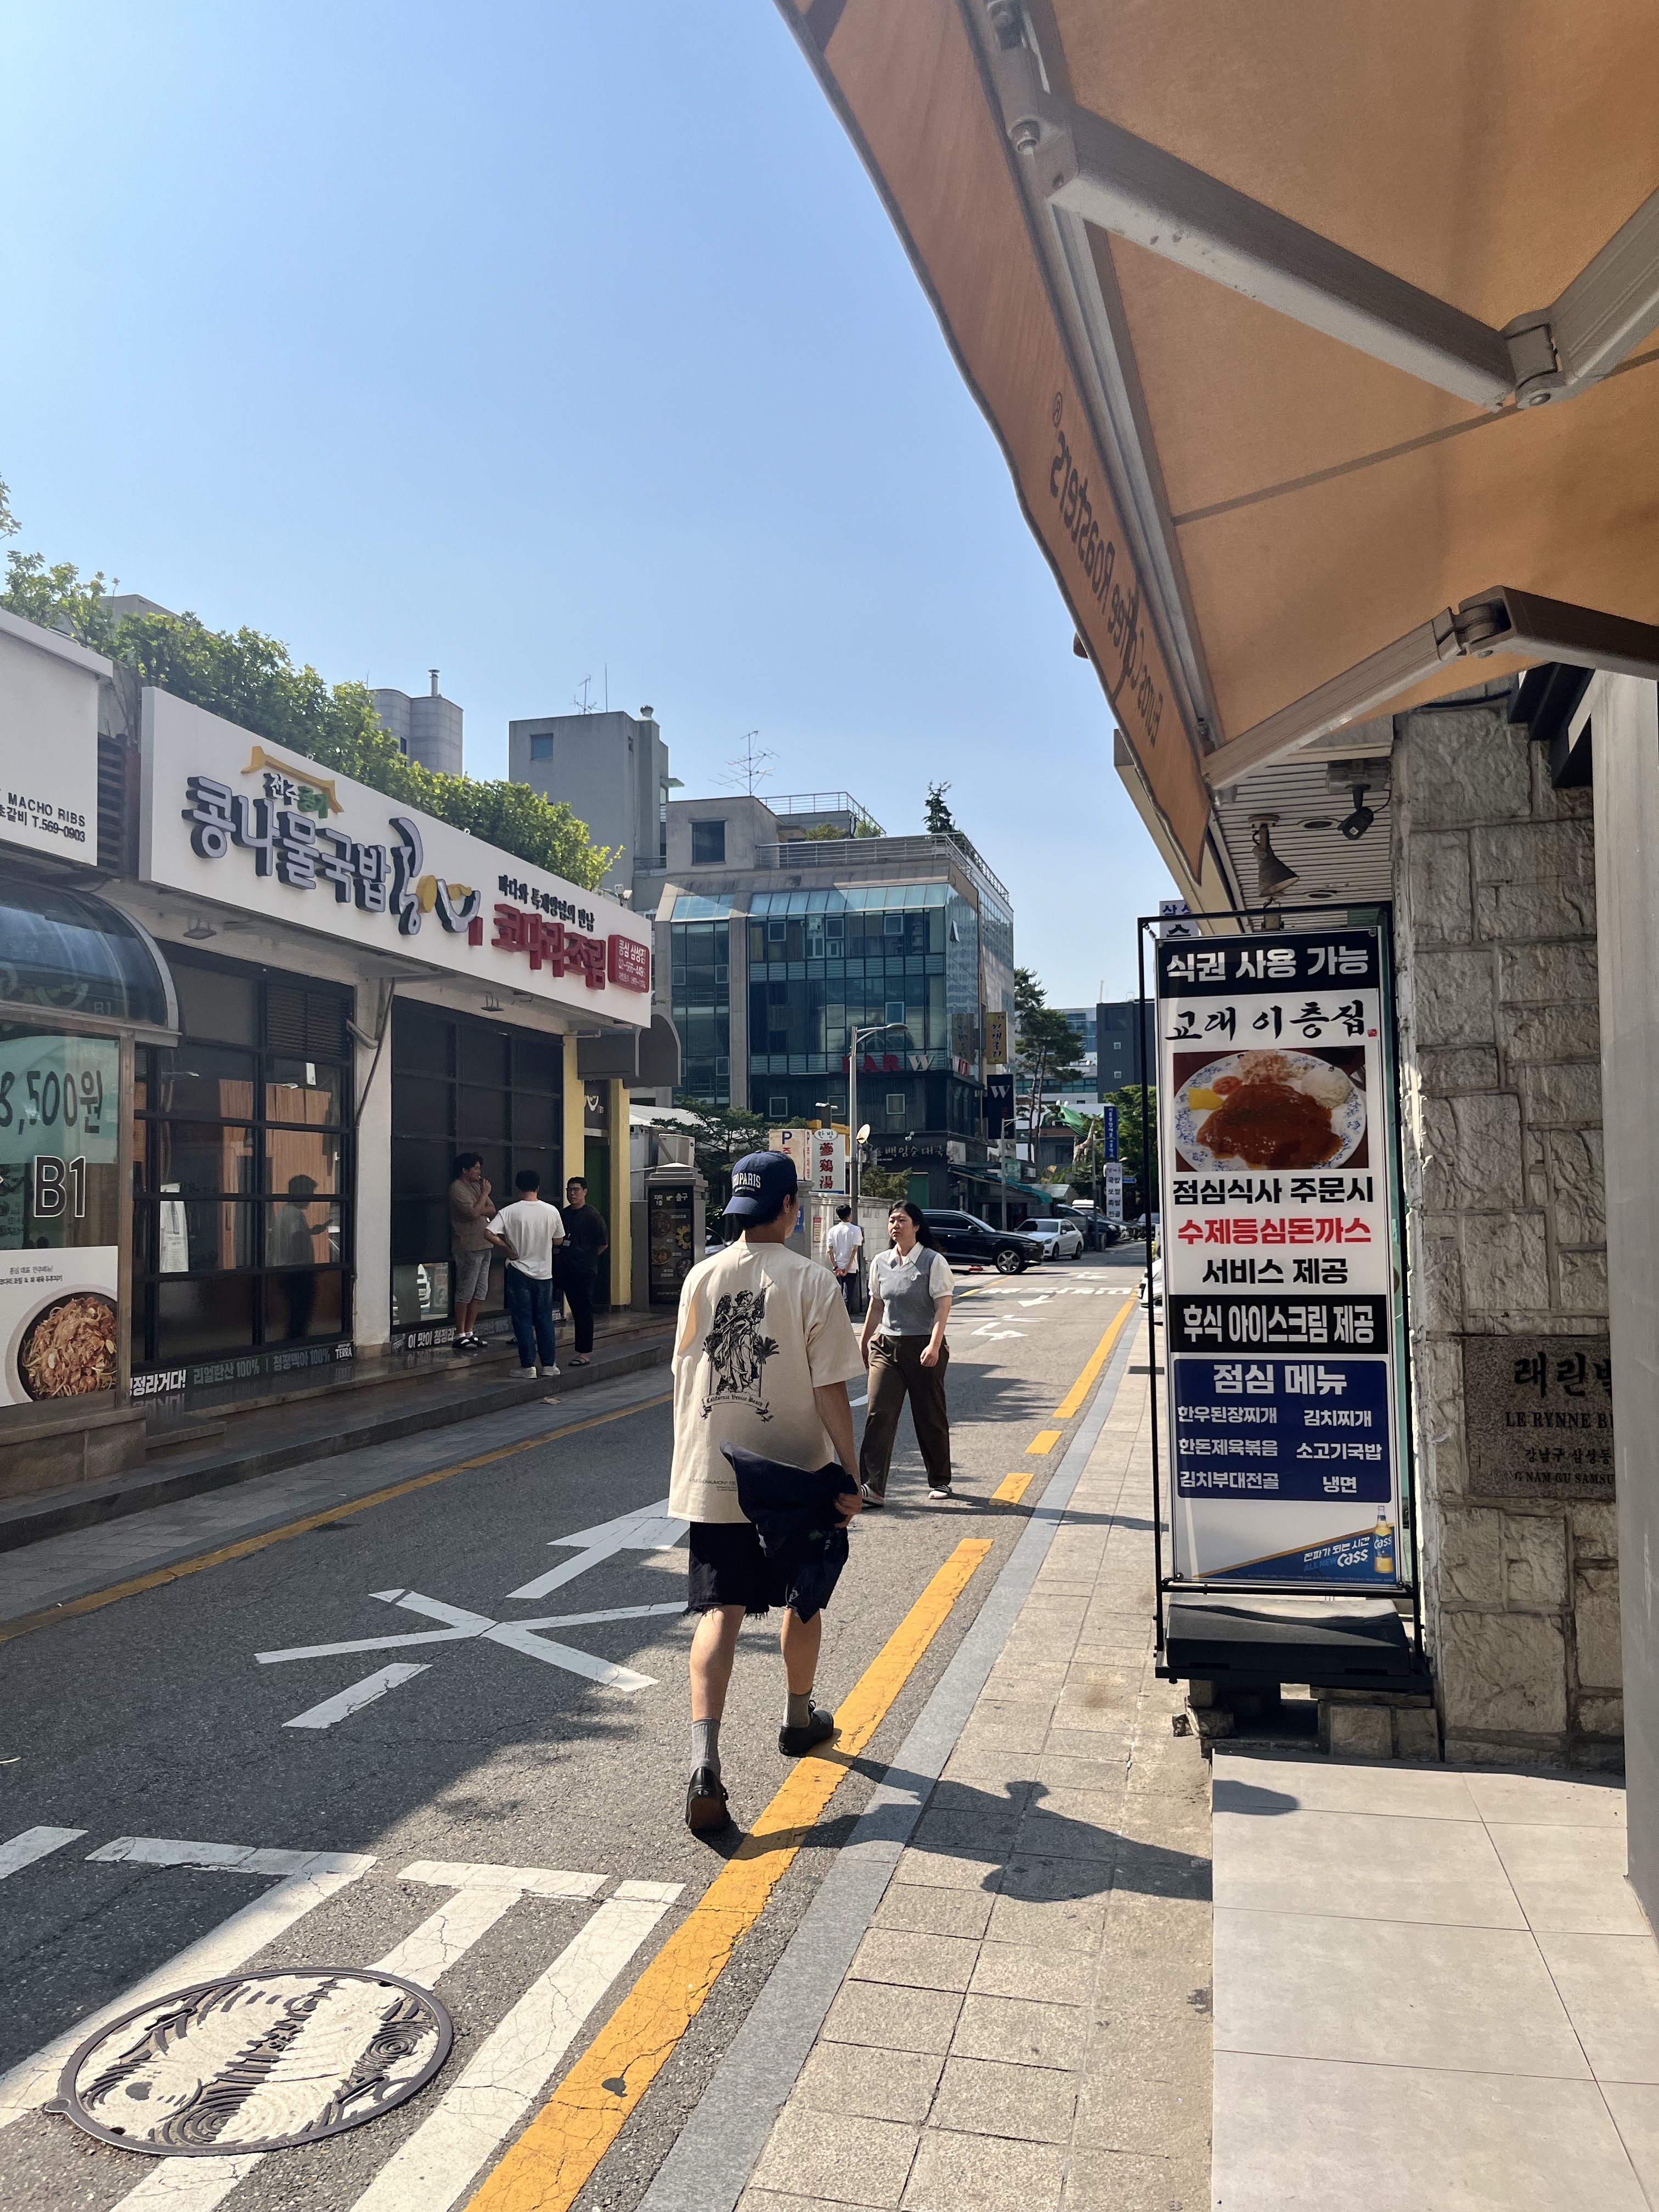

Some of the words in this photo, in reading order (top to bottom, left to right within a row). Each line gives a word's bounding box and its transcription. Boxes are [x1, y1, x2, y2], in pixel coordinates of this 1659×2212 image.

[8, 792, 53, 816] MACHO
[58, 807, 86, 827] RIBS
[31, 815, 86, 843] T.569-0903
[182, 775, 391, 914] 콩나물국밥
[498, 874, 529, 905] 바다와
[531, 888, 575, 924] 특제양념의
[578, 909, 595, 932] 만남
[492, 904, 606, 990] 코다리조림
[618, 939, 630, 958] 콩심
[630, 944, 647, 965] 삼성점
[1166, 951, 1227, 982] 식권
[1235, 948, 1296, 979] 사용
[1307, 945, 1369, 975] 가능
[1165, 1006, 1236, 1041] 교대
[1252, 999, 1365, 1039] 이층집
[908, 1054, 936, 1072] W
[0, 1069, 103, 1135] 8,500원
[990, 1085, 1011, 1098] W
[782, 1131, 793, 1145] P
[817, 1130, 834, 1139] 한방
[34, 1155, 86, 1217] B1
[739, 1172, 761, 1188] PARIS
[1173, 1178, 1282, 1205] 점심식사
[1290, 1176, 1374, 1204] 주문시
[1177, 1217, 1372, 1245] 수제등심돈까스
[1202, 1258, 1284, 1284] 서비스
[1293, 1258, 1348, 1284] 제공
[1183, 1304, 1223, 1342] 후식
[1228, 1305, 1328, 1344] 아이스크림
[1333, 1305, 1374, 1344] 제공
[408, 1333, 417, 1349] 이
[417, 1330, 432, 1347] 맛이
[432, 1327, 457, 1346] 청정라
[129, 1369, 187, 1398] 정라거다!
[193, 1363, 235, 1385] 리얼탄산
[236, 1358, 259, 1378] 100%
[335, 1347, 353, 1361] TERRA
[1213, 1364, 1275, 1395] 점심
[1284, 1364, 1347, 1395] 메뉴
[748, 1396, 764, 1407] Beach
[1177, 1406, 1278, 1424] 한우된장찌개
[1304, 1409, 1373, 1427] 김치찌개
[1505, 1411, 1526, 1427] LE
[1533, 1412, 1592, 1429] RYNNE
[1597, 1413, 1613, 1429] B
[1178, 1438, 1278, 1457] 한돈제육볶음
[1296, 1442, 1383, 1461] 소고기국밥
[1525, 1447, 1565, 1463] 강남구
[1570, 1447, 1612, 1465] 삼성동
[1180, 1470, 1279, 1490] 김치부대전골
[1322, 1476, 1357, 1494] 냉면
[1332, 1542, 1351, 1555] 되는
[1351, 1536, 1370, 1549] 시간
[1374, 1536, 1392, 1549] Cass
[1336, 1548, 1369, 1568] Cass
